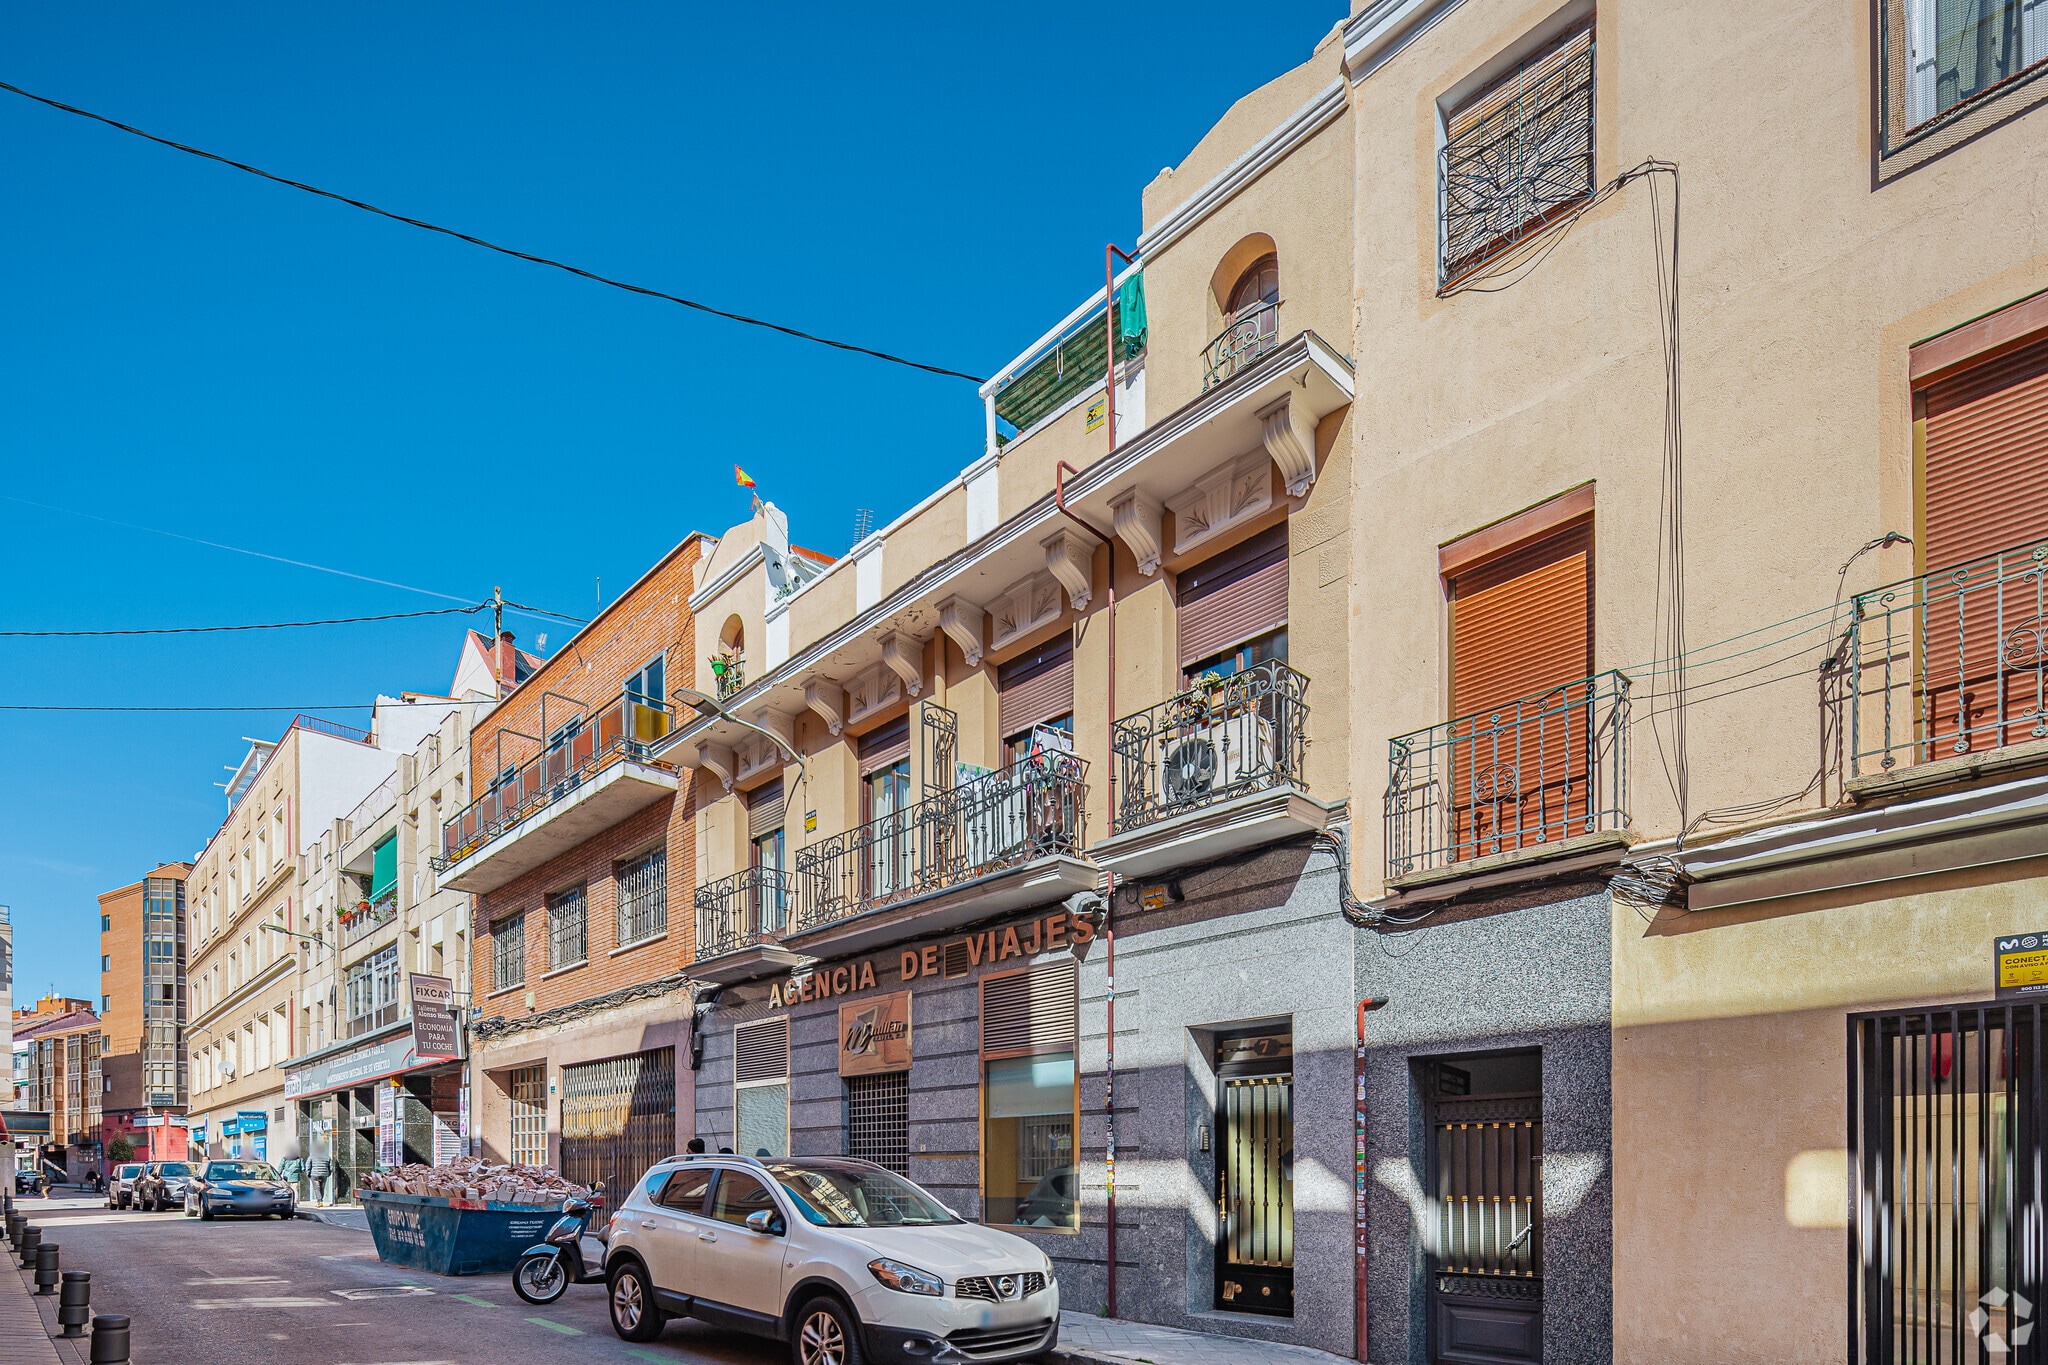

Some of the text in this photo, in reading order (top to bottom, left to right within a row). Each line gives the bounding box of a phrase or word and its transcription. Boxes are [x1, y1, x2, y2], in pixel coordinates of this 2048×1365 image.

[768, 913, 1094, 1009] AGENCIA DE VIAJES
[2005, 955, 2048, 965] CONECT
[416, 986, 451, 1000] FIXCAR
[417, 1004, 437, 1013] Talleres
[417, 1010, 437, 1018] Alonso
[418, 1022, 454, 1033] ECONOMÍA
[428, 1033, 446, 1041] PARA
[422, 1041, 453, 1051] TU COCHE
[1260, 1040, 1269, 1053] 7
